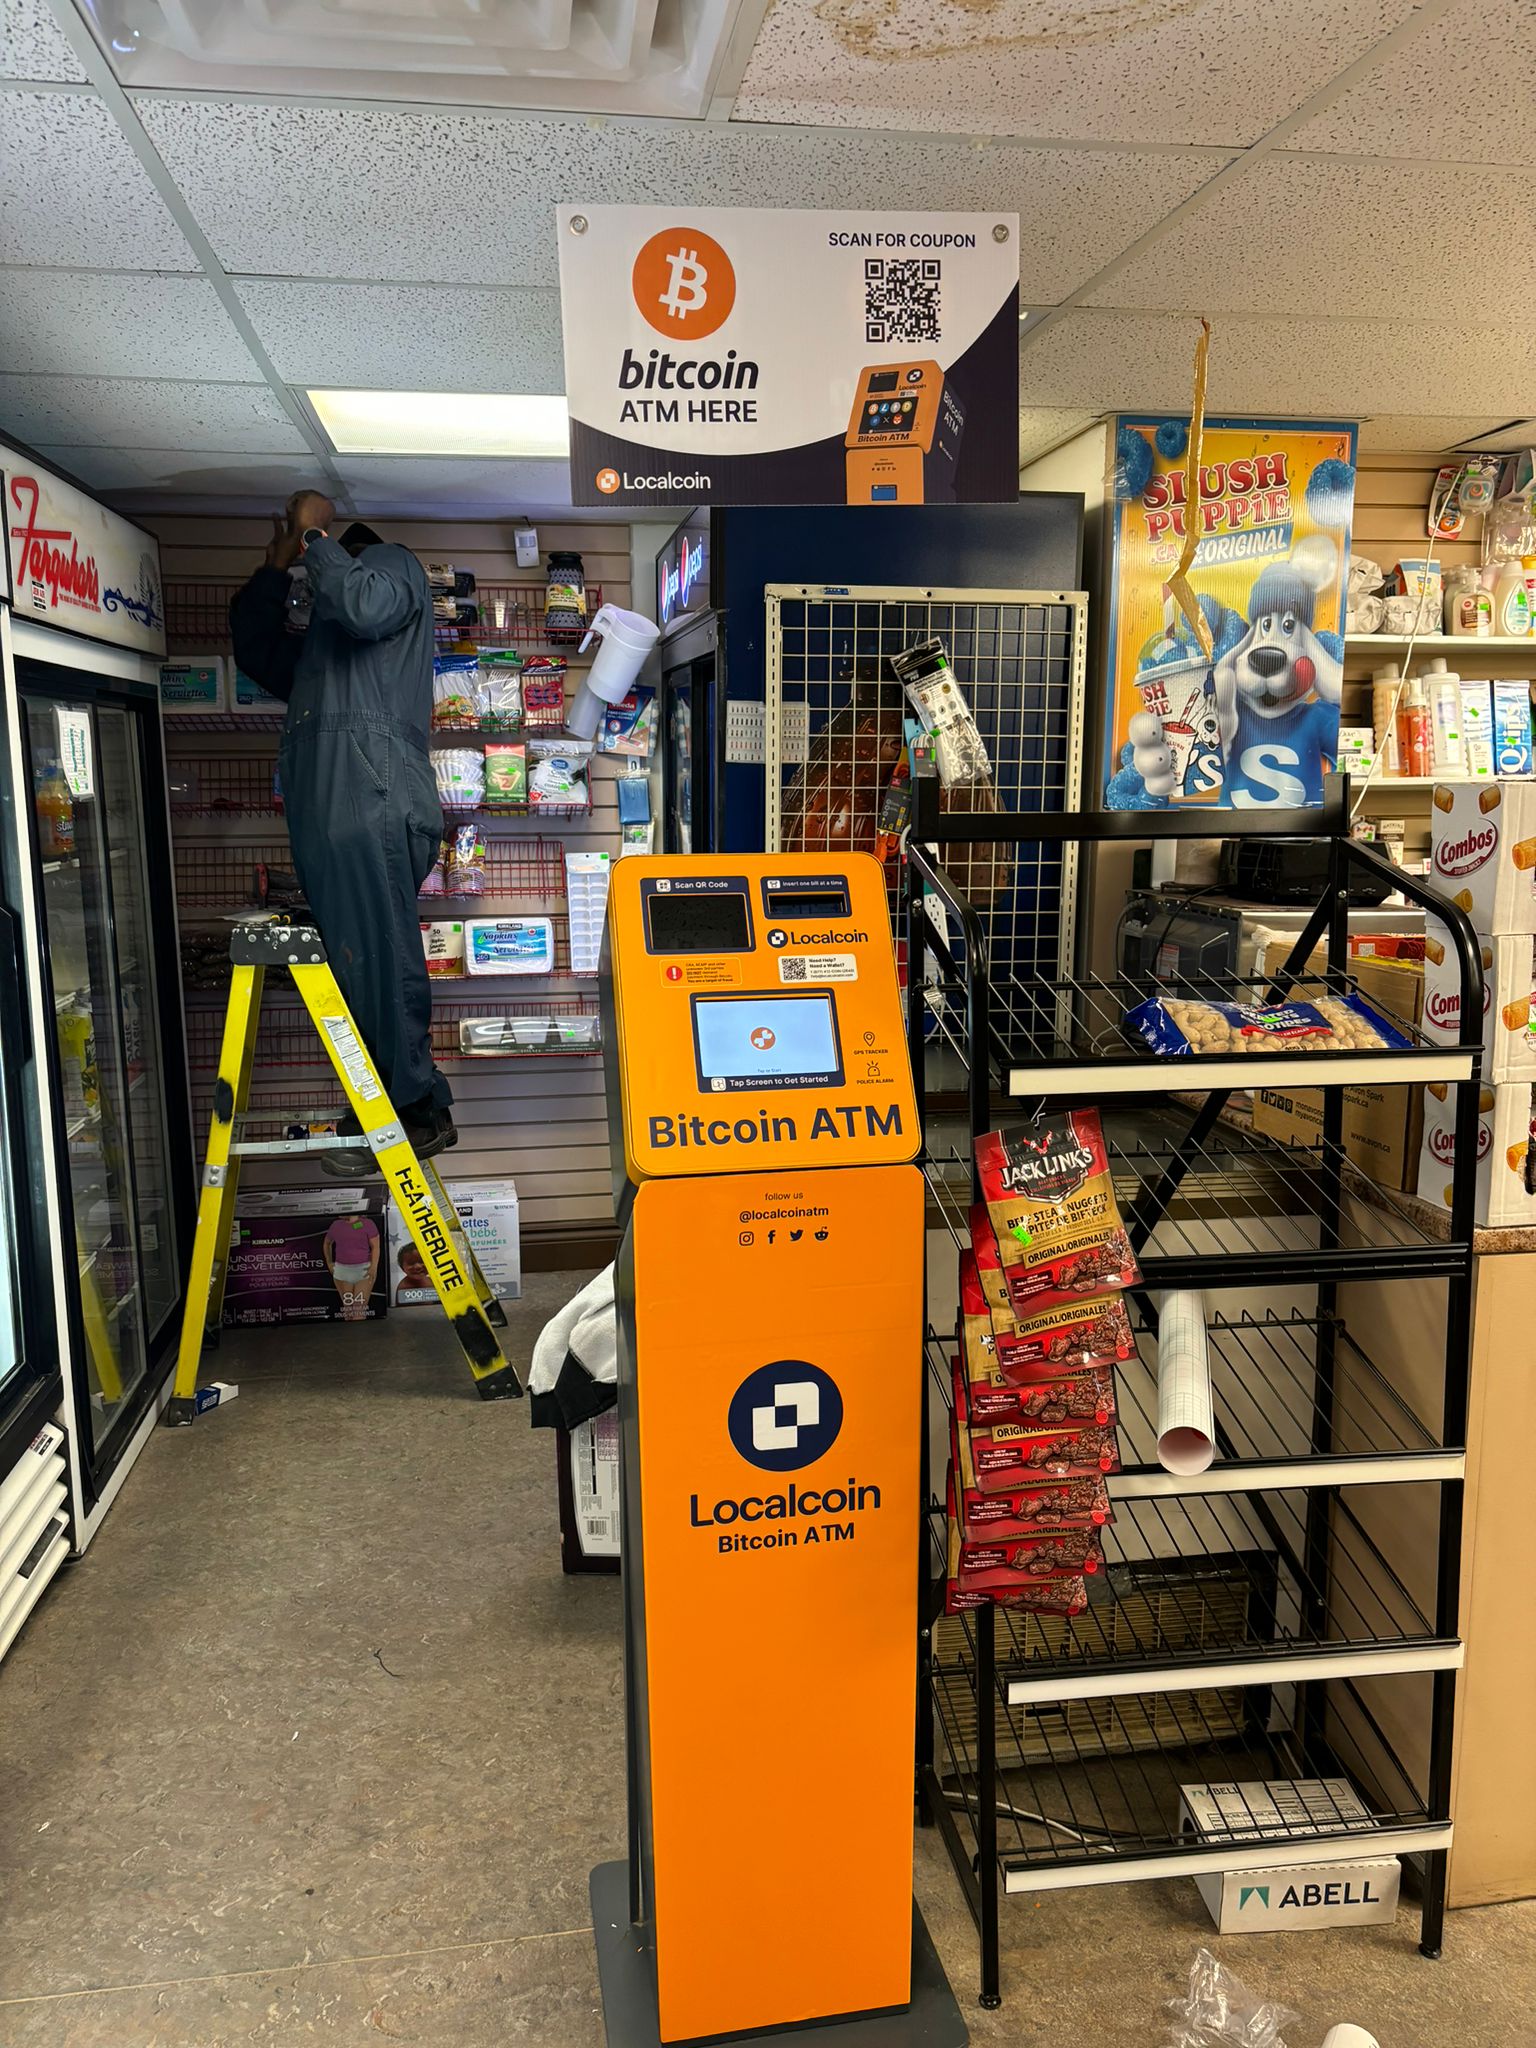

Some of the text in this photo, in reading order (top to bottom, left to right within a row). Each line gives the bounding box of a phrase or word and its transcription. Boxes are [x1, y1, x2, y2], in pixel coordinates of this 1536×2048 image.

[828, 232, 976, 249] SCAN FOR COUPON
[618, 349, 759, 391] bitcoin
[619, 400, 758, 424] ATM HERE
[857, 433, 910, 443] Bitcoin ATM
[623, 471, 712, 491] Localcoin
[1441, 829, 1494, 865] Combos
[674, 882, 694, 890] Scan
[696, 881, 708, 889] QR
[790, 929, 869, 946] Localcoin
[1431, 993, 1460, 1016] Com
[730, 1080, 744, 1088] Tap
[746, 1078, 774, 1086] Screen
[784, 1077, 799, 1085] Get
[800, 1076, 829, 1084] Started
[1343, 1093, 1369, 1108] spark.ca
[648, 1104, 904, 1149] Bitcoin ATM
[1002, 1161, 1046, 1189] JACK
[764, 1192, 804, 1202] follow us
[462, 1218, 490, 1228] ettes
[739, 1206, 830, 1223] @localcoinatm
[395, 1167, 464, 1292] FEATHERLITE
[470, 1226, 498, 1238] bébé
[1028, 1232, 1110, 1264] ORIGINAL/ORIGINALES
[227, 1259, 324, 1272] OUS-VÊTEMENTS
[230, 1252, 308, 1264] UNDERWEAR
[342, 1292, 366, 1306] 84
[404, 1290, 423, 1299] 900
[1019, 1304, 1108, 1334] ORIGINAL/ORIGINALES
[690, 1478, 881, 1527] Localcoin
[718, 1522, 855, 1553] Bitcoin ATM
[1278, 1880, 1380, 1910] ABELL
